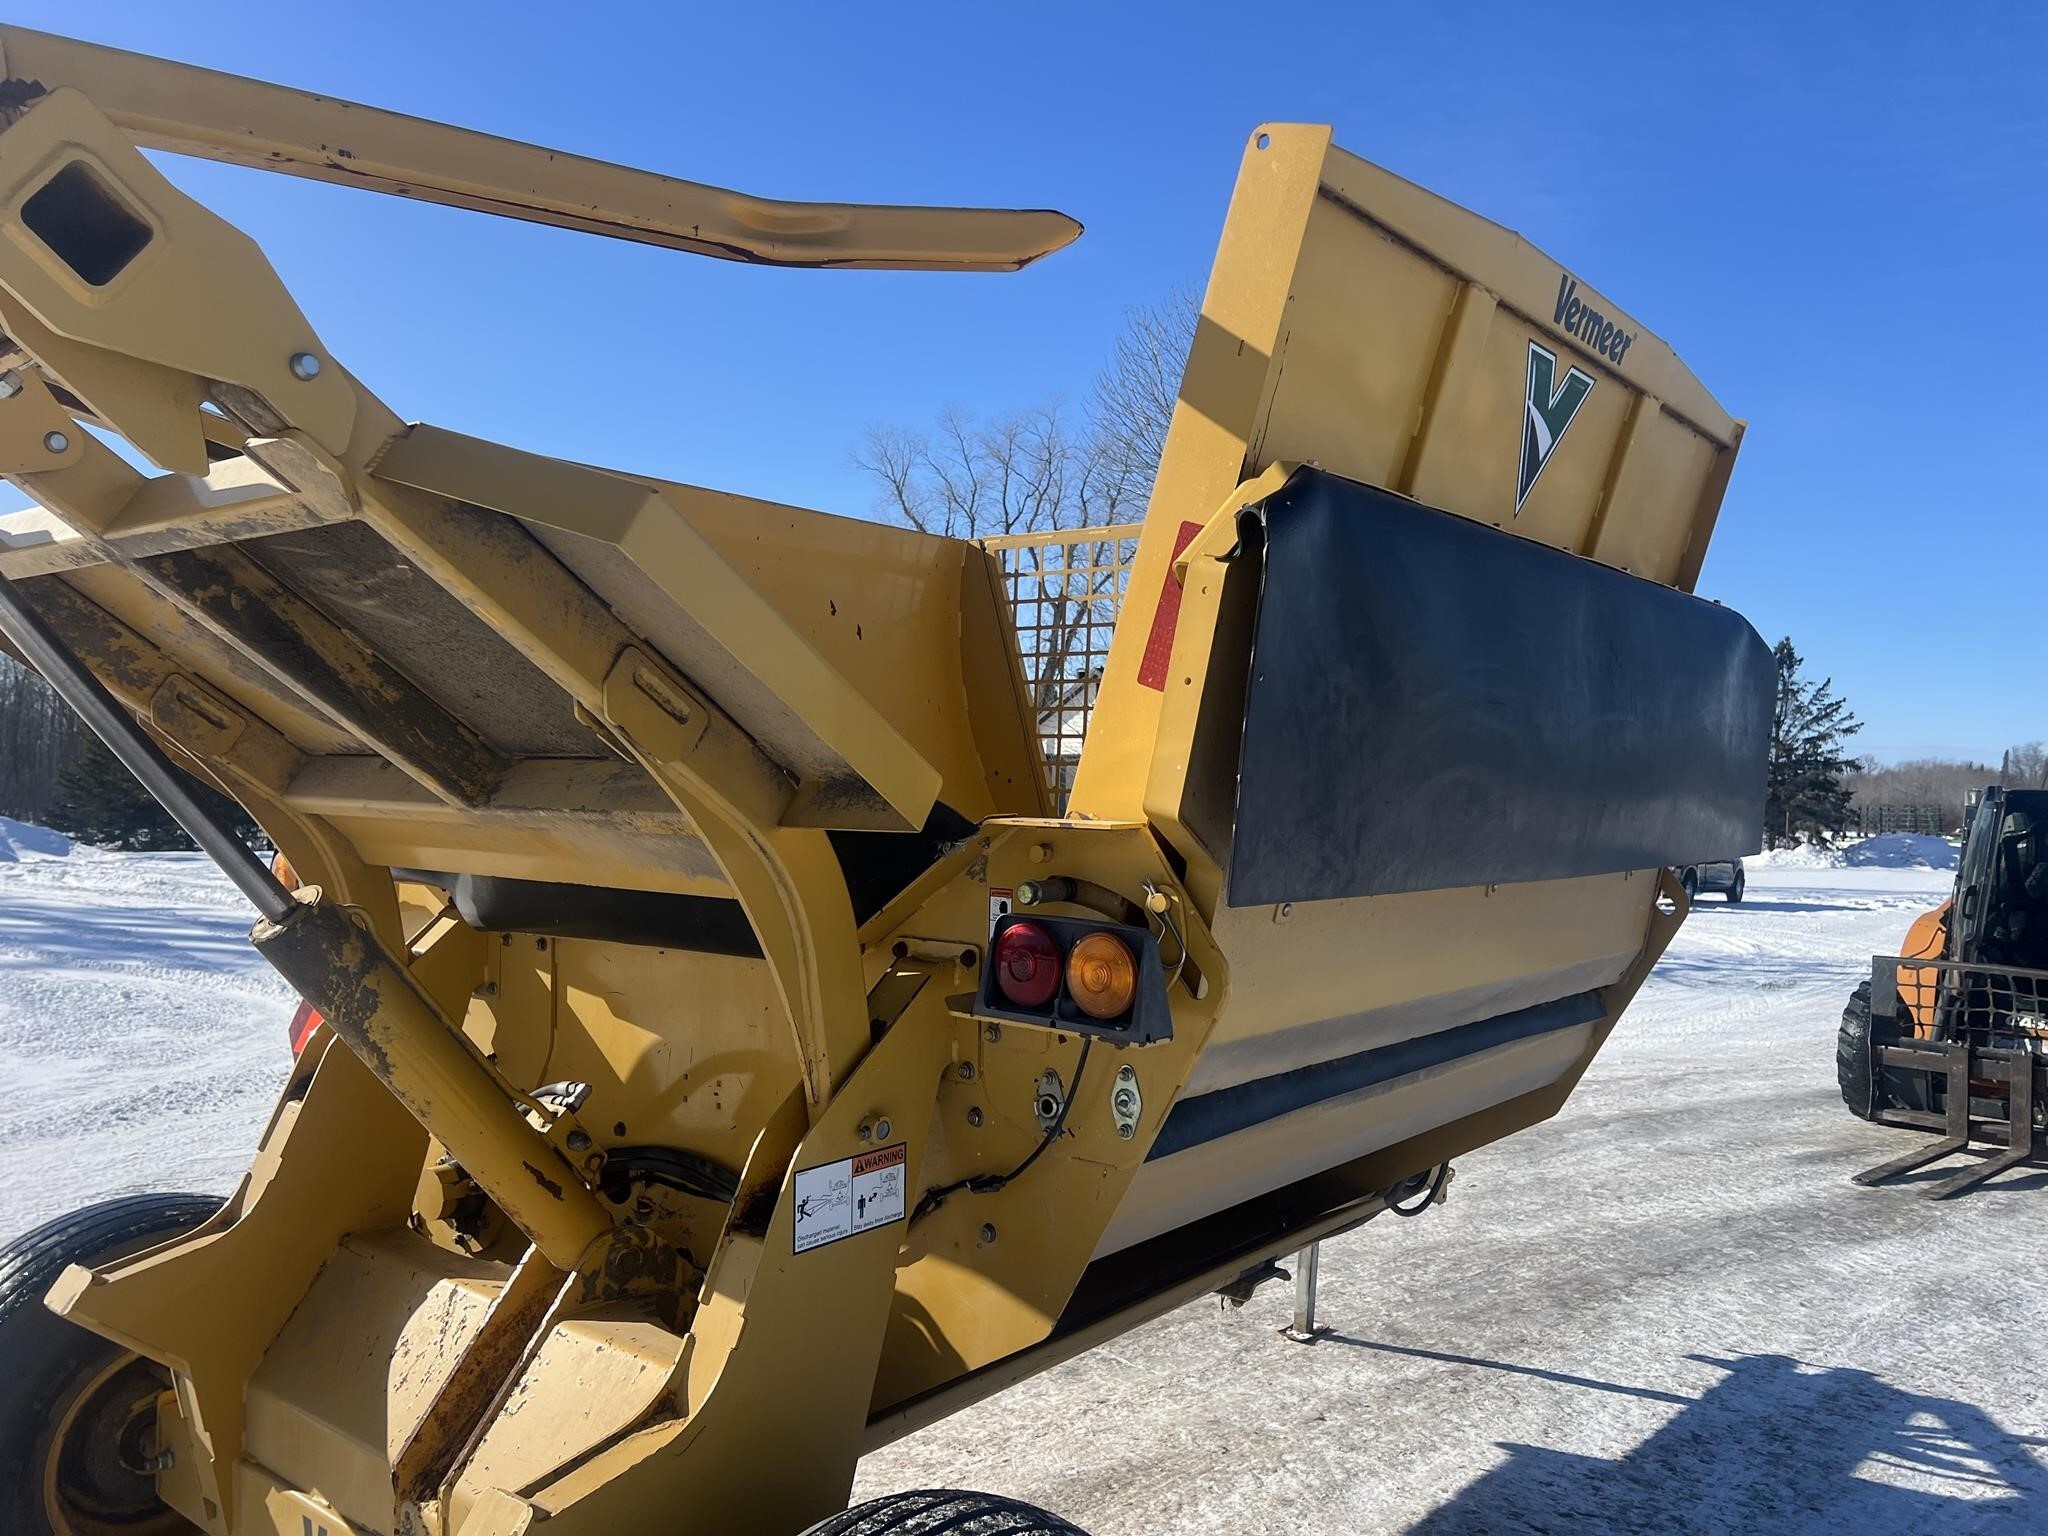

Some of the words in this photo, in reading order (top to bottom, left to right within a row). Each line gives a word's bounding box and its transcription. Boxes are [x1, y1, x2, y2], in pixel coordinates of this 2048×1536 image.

[1553, 273, 1633, 366] Vermeer
[864, 1149, 903, 1167] WARNING
[797, 1230, 822, 1243] Discharged
[822, 1224, 840, 1234] material
[797, 1242, 806, 1250] can
[806, 1238, 819, 1246] cause
